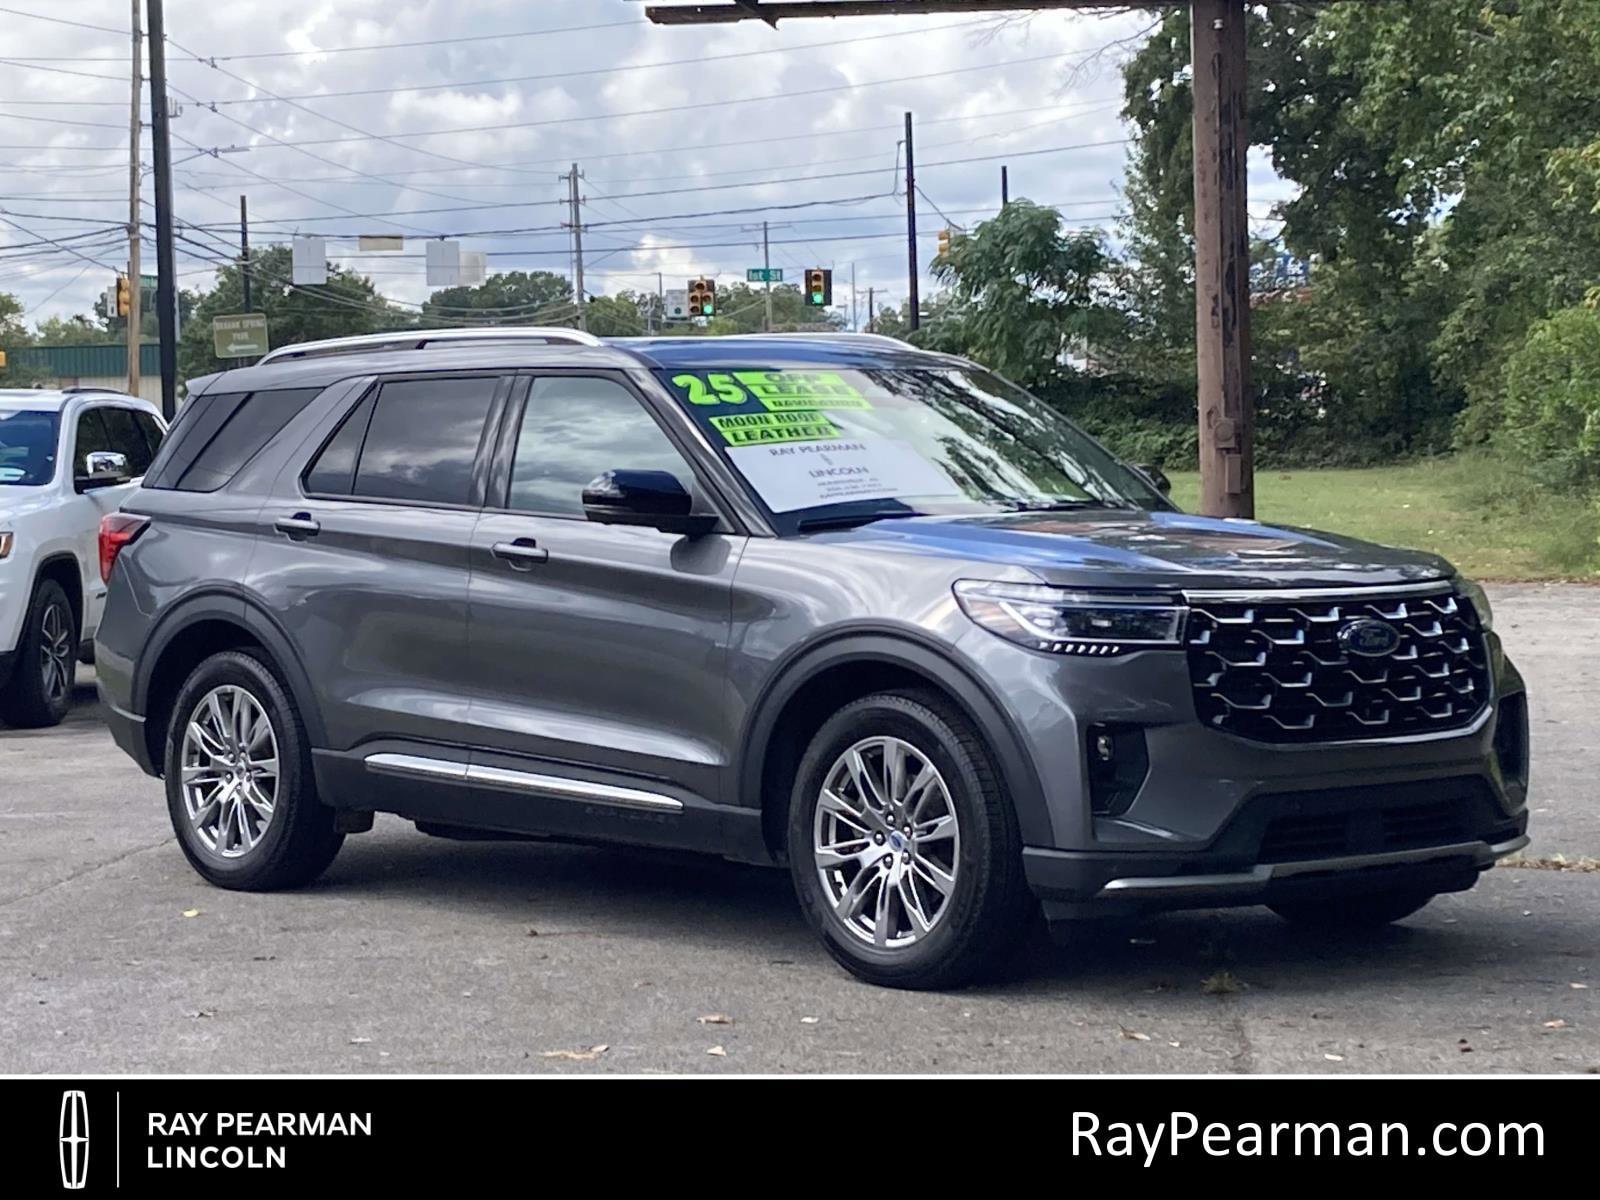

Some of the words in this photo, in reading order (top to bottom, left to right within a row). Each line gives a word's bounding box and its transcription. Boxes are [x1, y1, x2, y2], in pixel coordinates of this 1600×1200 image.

[671, 373, 749, 406] 25
[716, 413, 772, 429] MOON
[775, 411, 821, 425] ROOF
[731, 426, 834, 443] LEATHER
[768, 446, 796, 457] RAY
[798, 444, 867, 455] PEARMAN
[808, 467, 870, 479] LINCOLN
